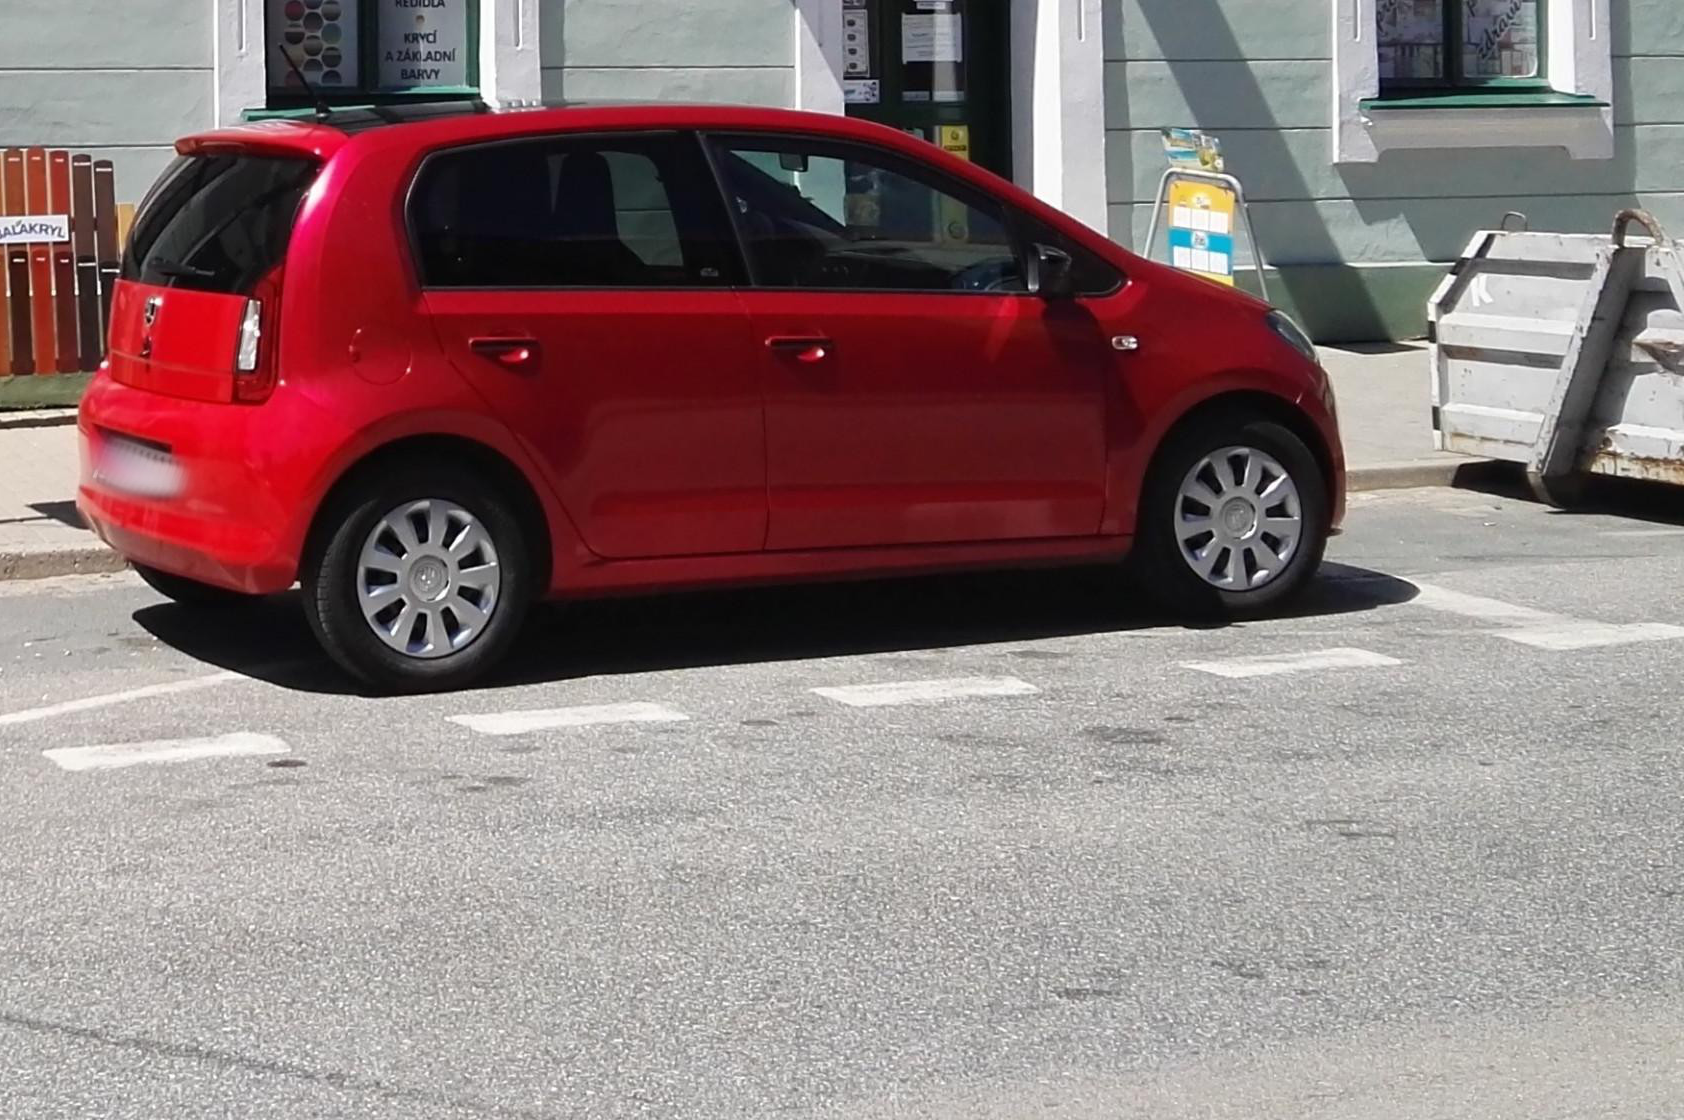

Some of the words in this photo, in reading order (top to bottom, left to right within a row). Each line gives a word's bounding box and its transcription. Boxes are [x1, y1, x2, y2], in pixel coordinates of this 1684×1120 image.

[404, 29, 437, 44] KRYCÍ
[385, 51, 394, 61] A
[396, 48, 456, 62] ZÁKLADNÍ
[401, 68, 440, 80] BARVY
